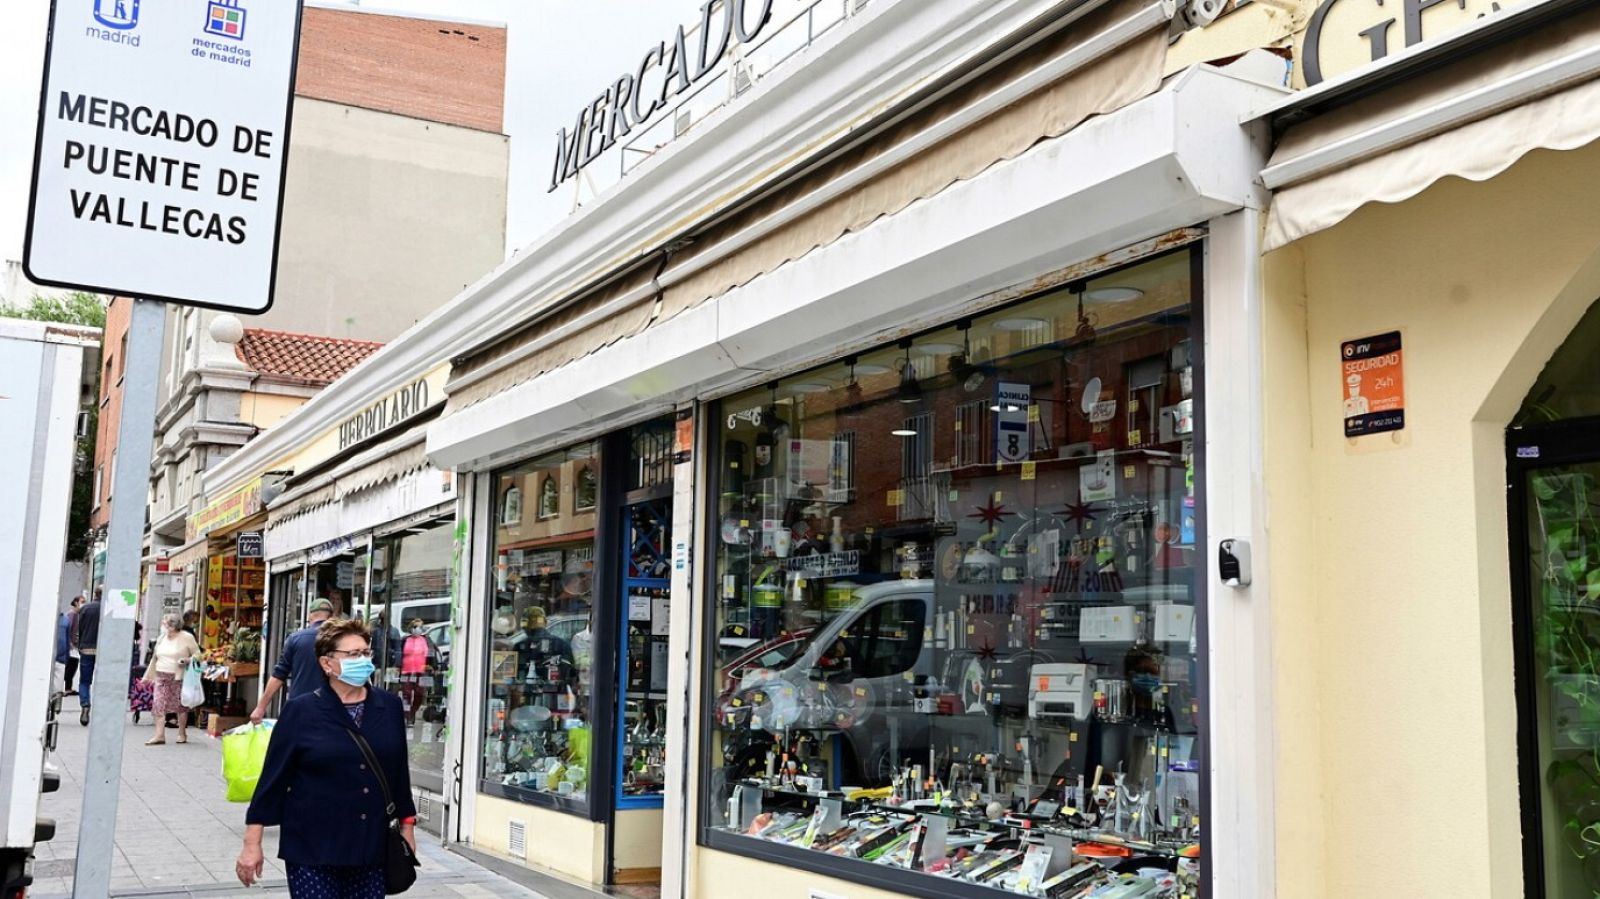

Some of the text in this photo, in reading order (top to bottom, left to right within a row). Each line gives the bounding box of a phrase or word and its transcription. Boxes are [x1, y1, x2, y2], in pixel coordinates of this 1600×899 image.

[85, 24, 141, 47] madrid
[192, 36, 252, 58] mercados
[191, 46, 252, 68] de madrid
[59, 90, 273, 158] MERCADO DE
[63, 140, 260, 201] PUENTE DE
[69, 189, 248, 245] VALLECAS
[1344, 353, 1400, 374] SEGURIDAD
[338, 378, 430, 451] HERBOLARIO
